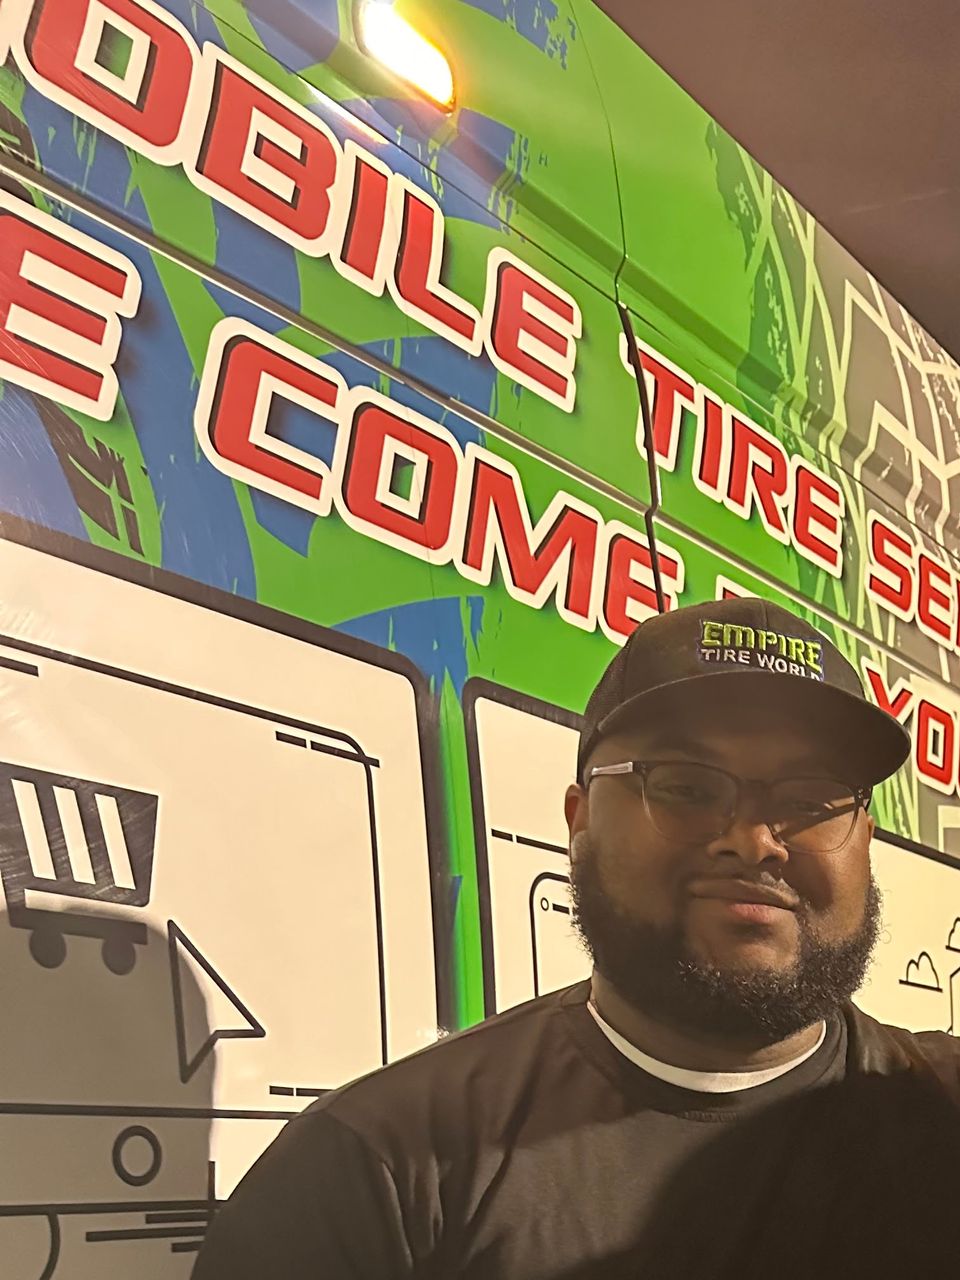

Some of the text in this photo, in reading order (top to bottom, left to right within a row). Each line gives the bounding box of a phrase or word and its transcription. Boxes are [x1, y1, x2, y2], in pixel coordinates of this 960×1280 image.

[12, 0, 578, 405] OBILE
[624, 338, 840, 572] TIRE
[202, 325, 680, 641] COME
[701, 648, 750, 665] TIRE
[702, 621, 822, 673] EMPIRE
